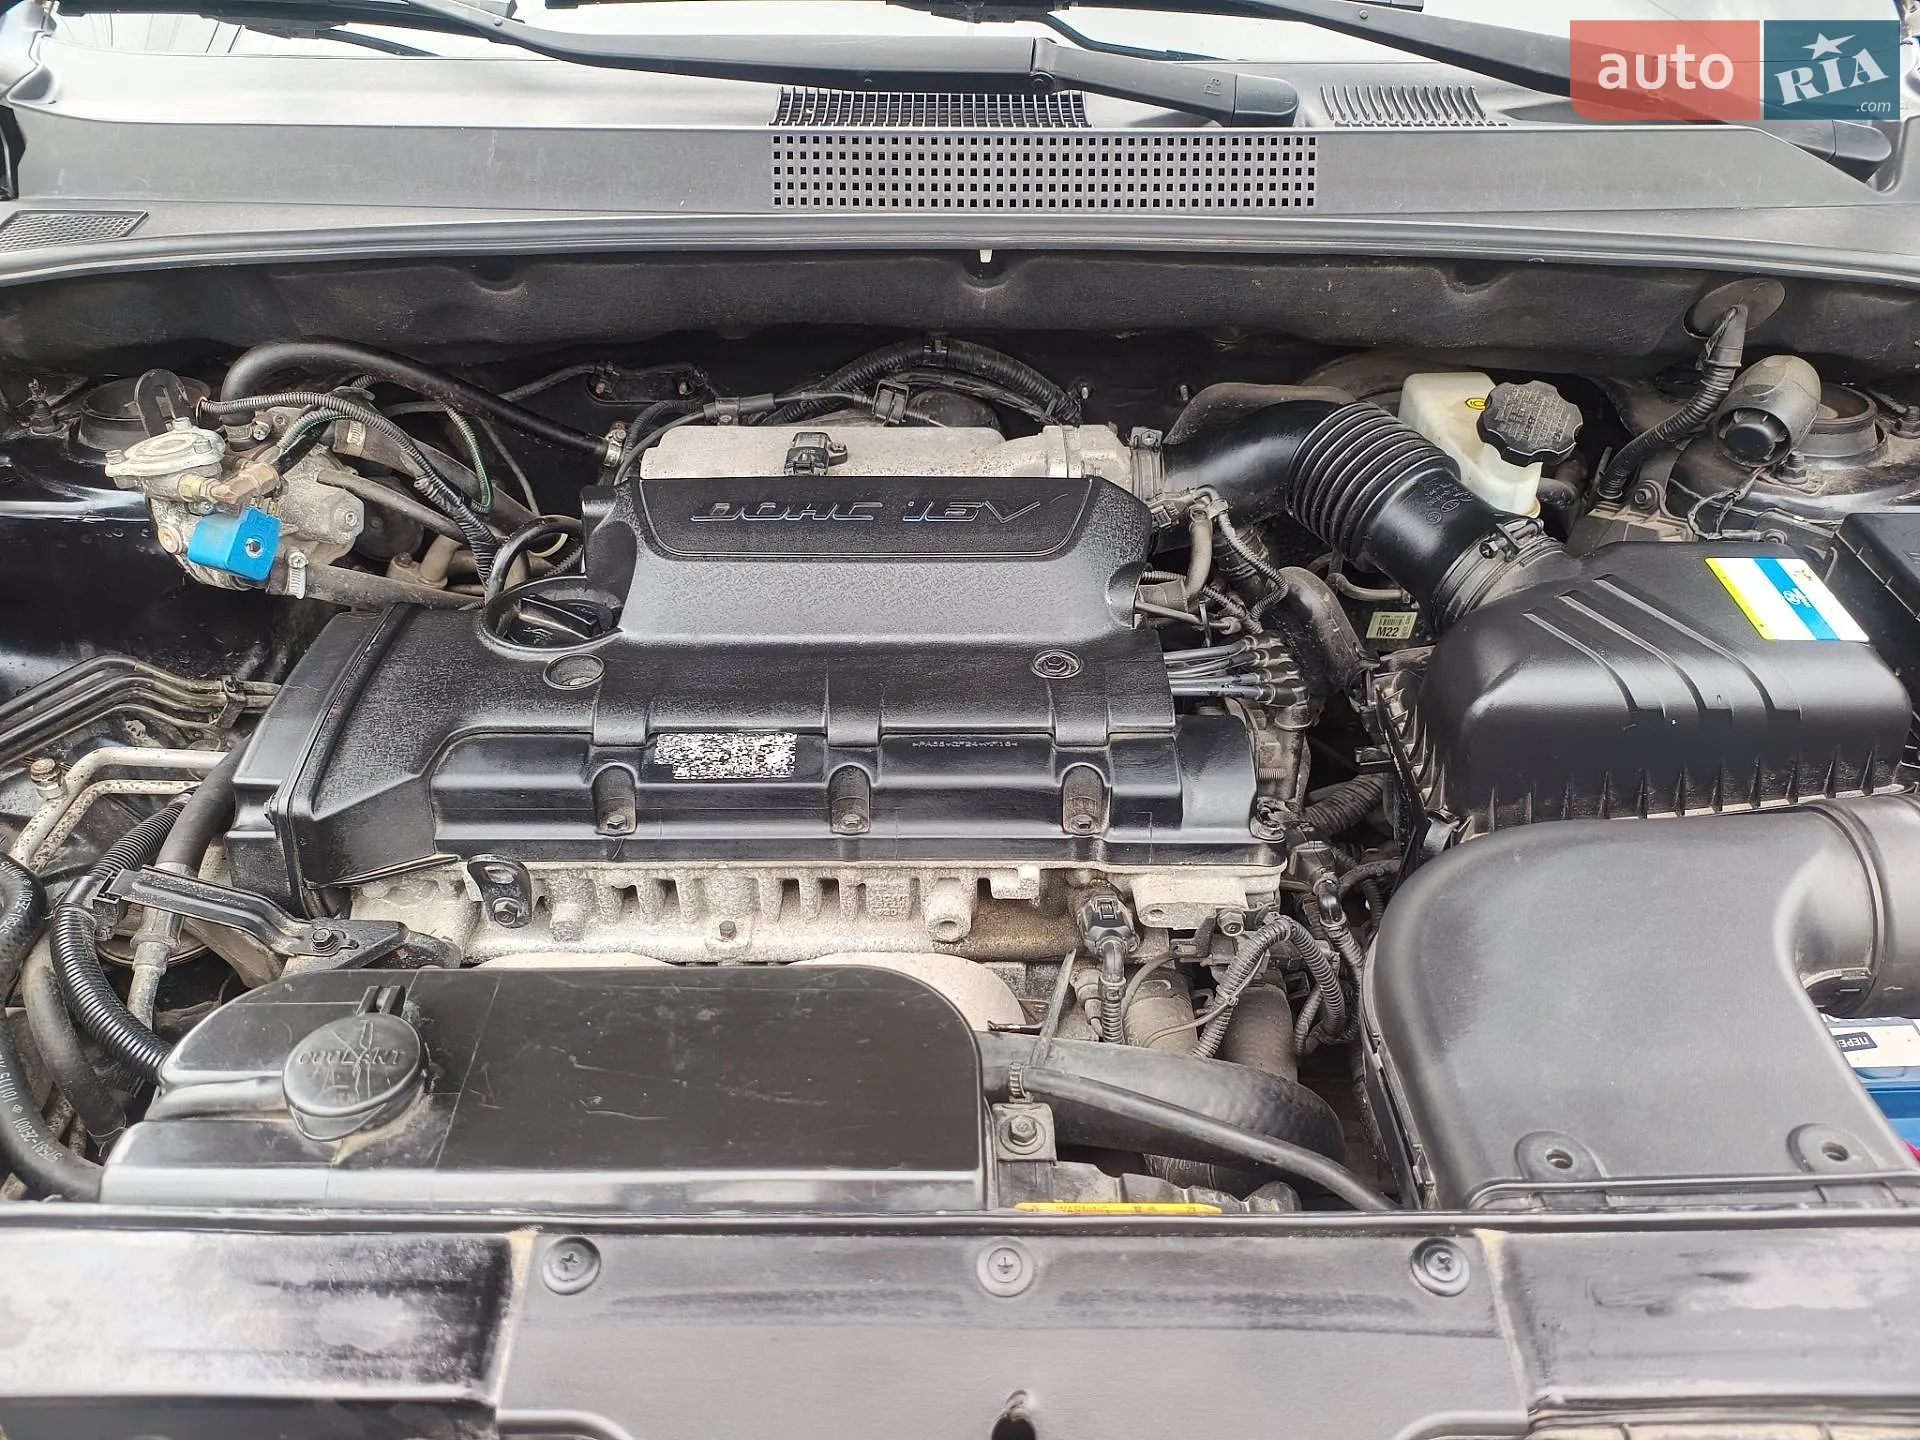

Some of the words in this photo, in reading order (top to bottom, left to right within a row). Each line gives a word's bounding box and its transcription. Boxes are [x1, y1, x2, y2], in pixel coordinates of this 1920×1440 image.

[691, 502, 884, 522] DOHC
[903, 500, 1041, 523] 16V
[1376, 626, 1400, 637] M22
[1837, 1036, 1870, 1049] ПЕРЕ
